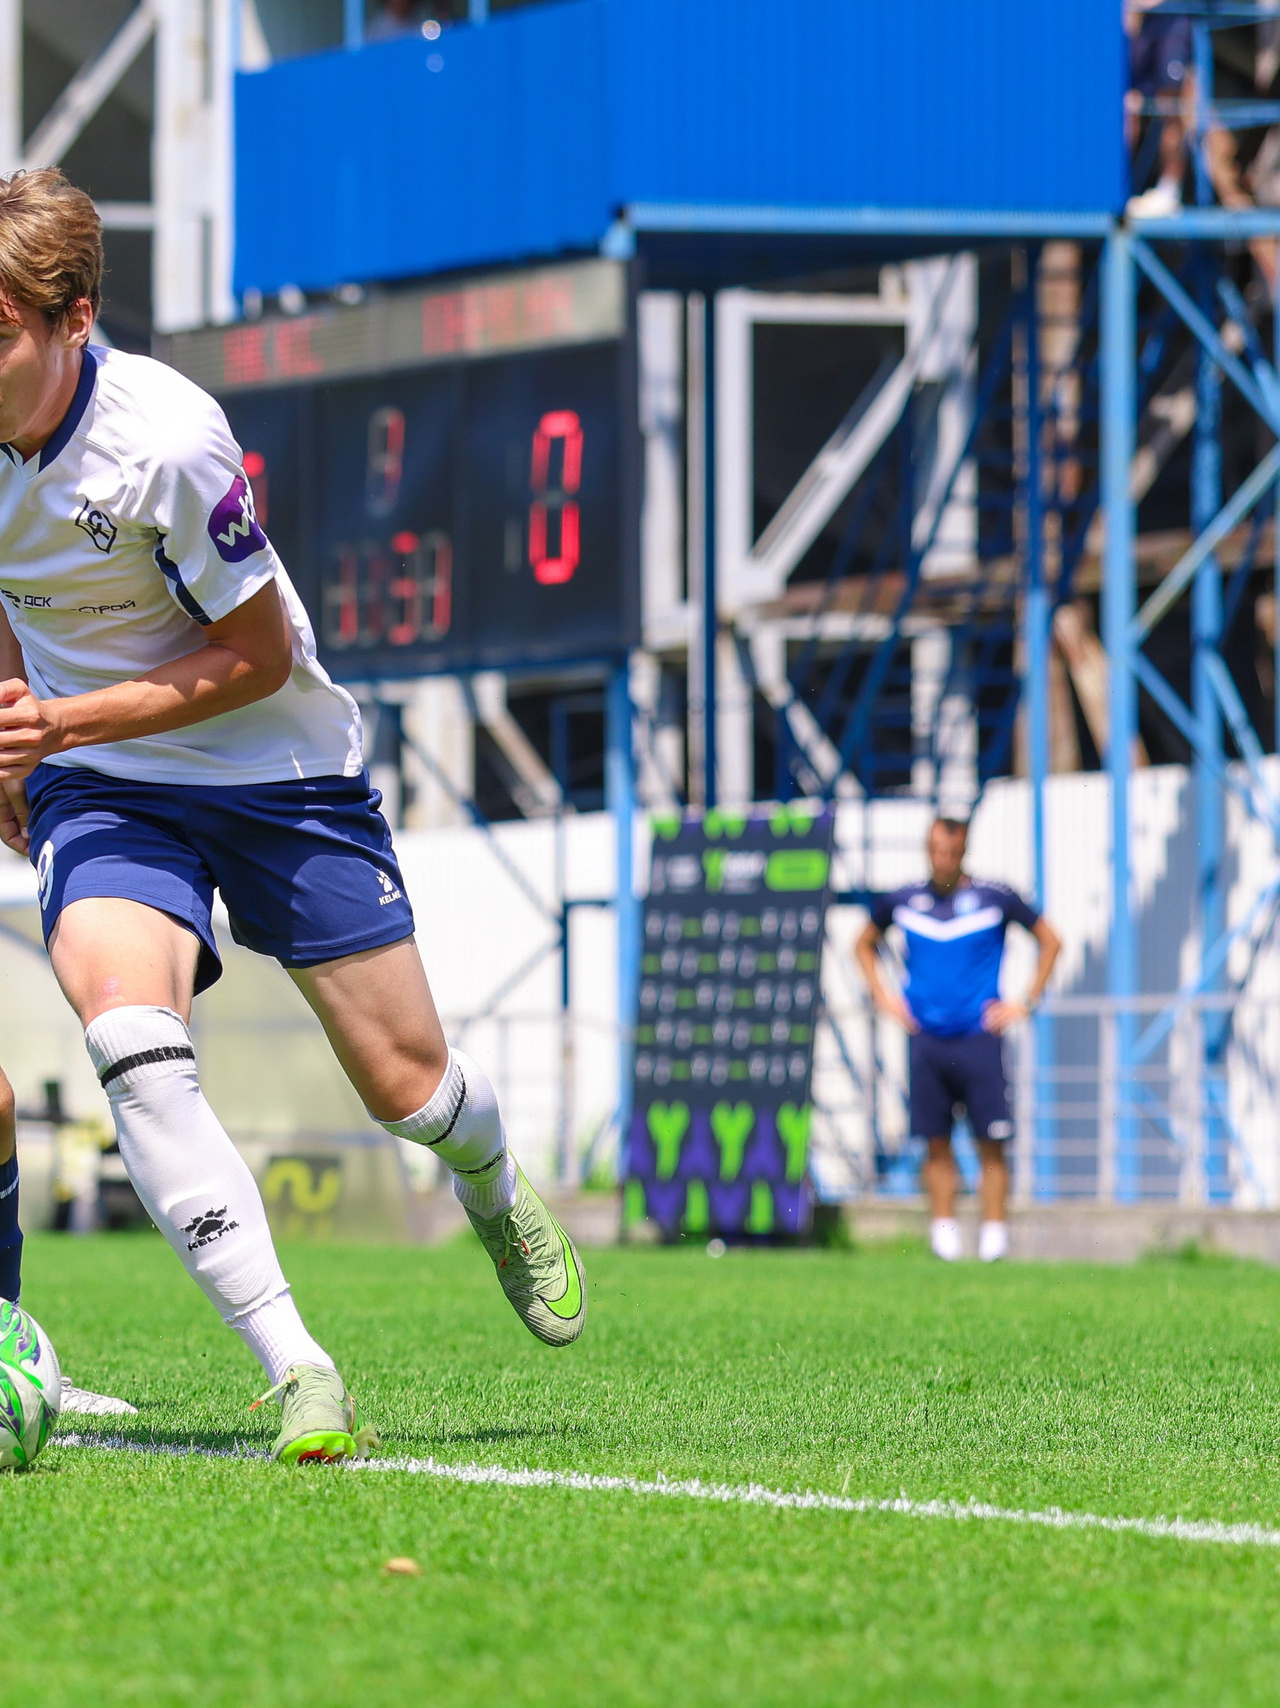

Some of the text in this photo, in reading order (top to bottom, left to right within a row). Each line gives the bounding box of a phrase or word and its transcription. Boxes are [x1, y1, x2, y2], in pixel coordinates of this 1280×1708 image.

[529, 409, 583, 585] 0
[379, 890, 402, 906] KELME
[187, 1220, 239, 1252] KELME
